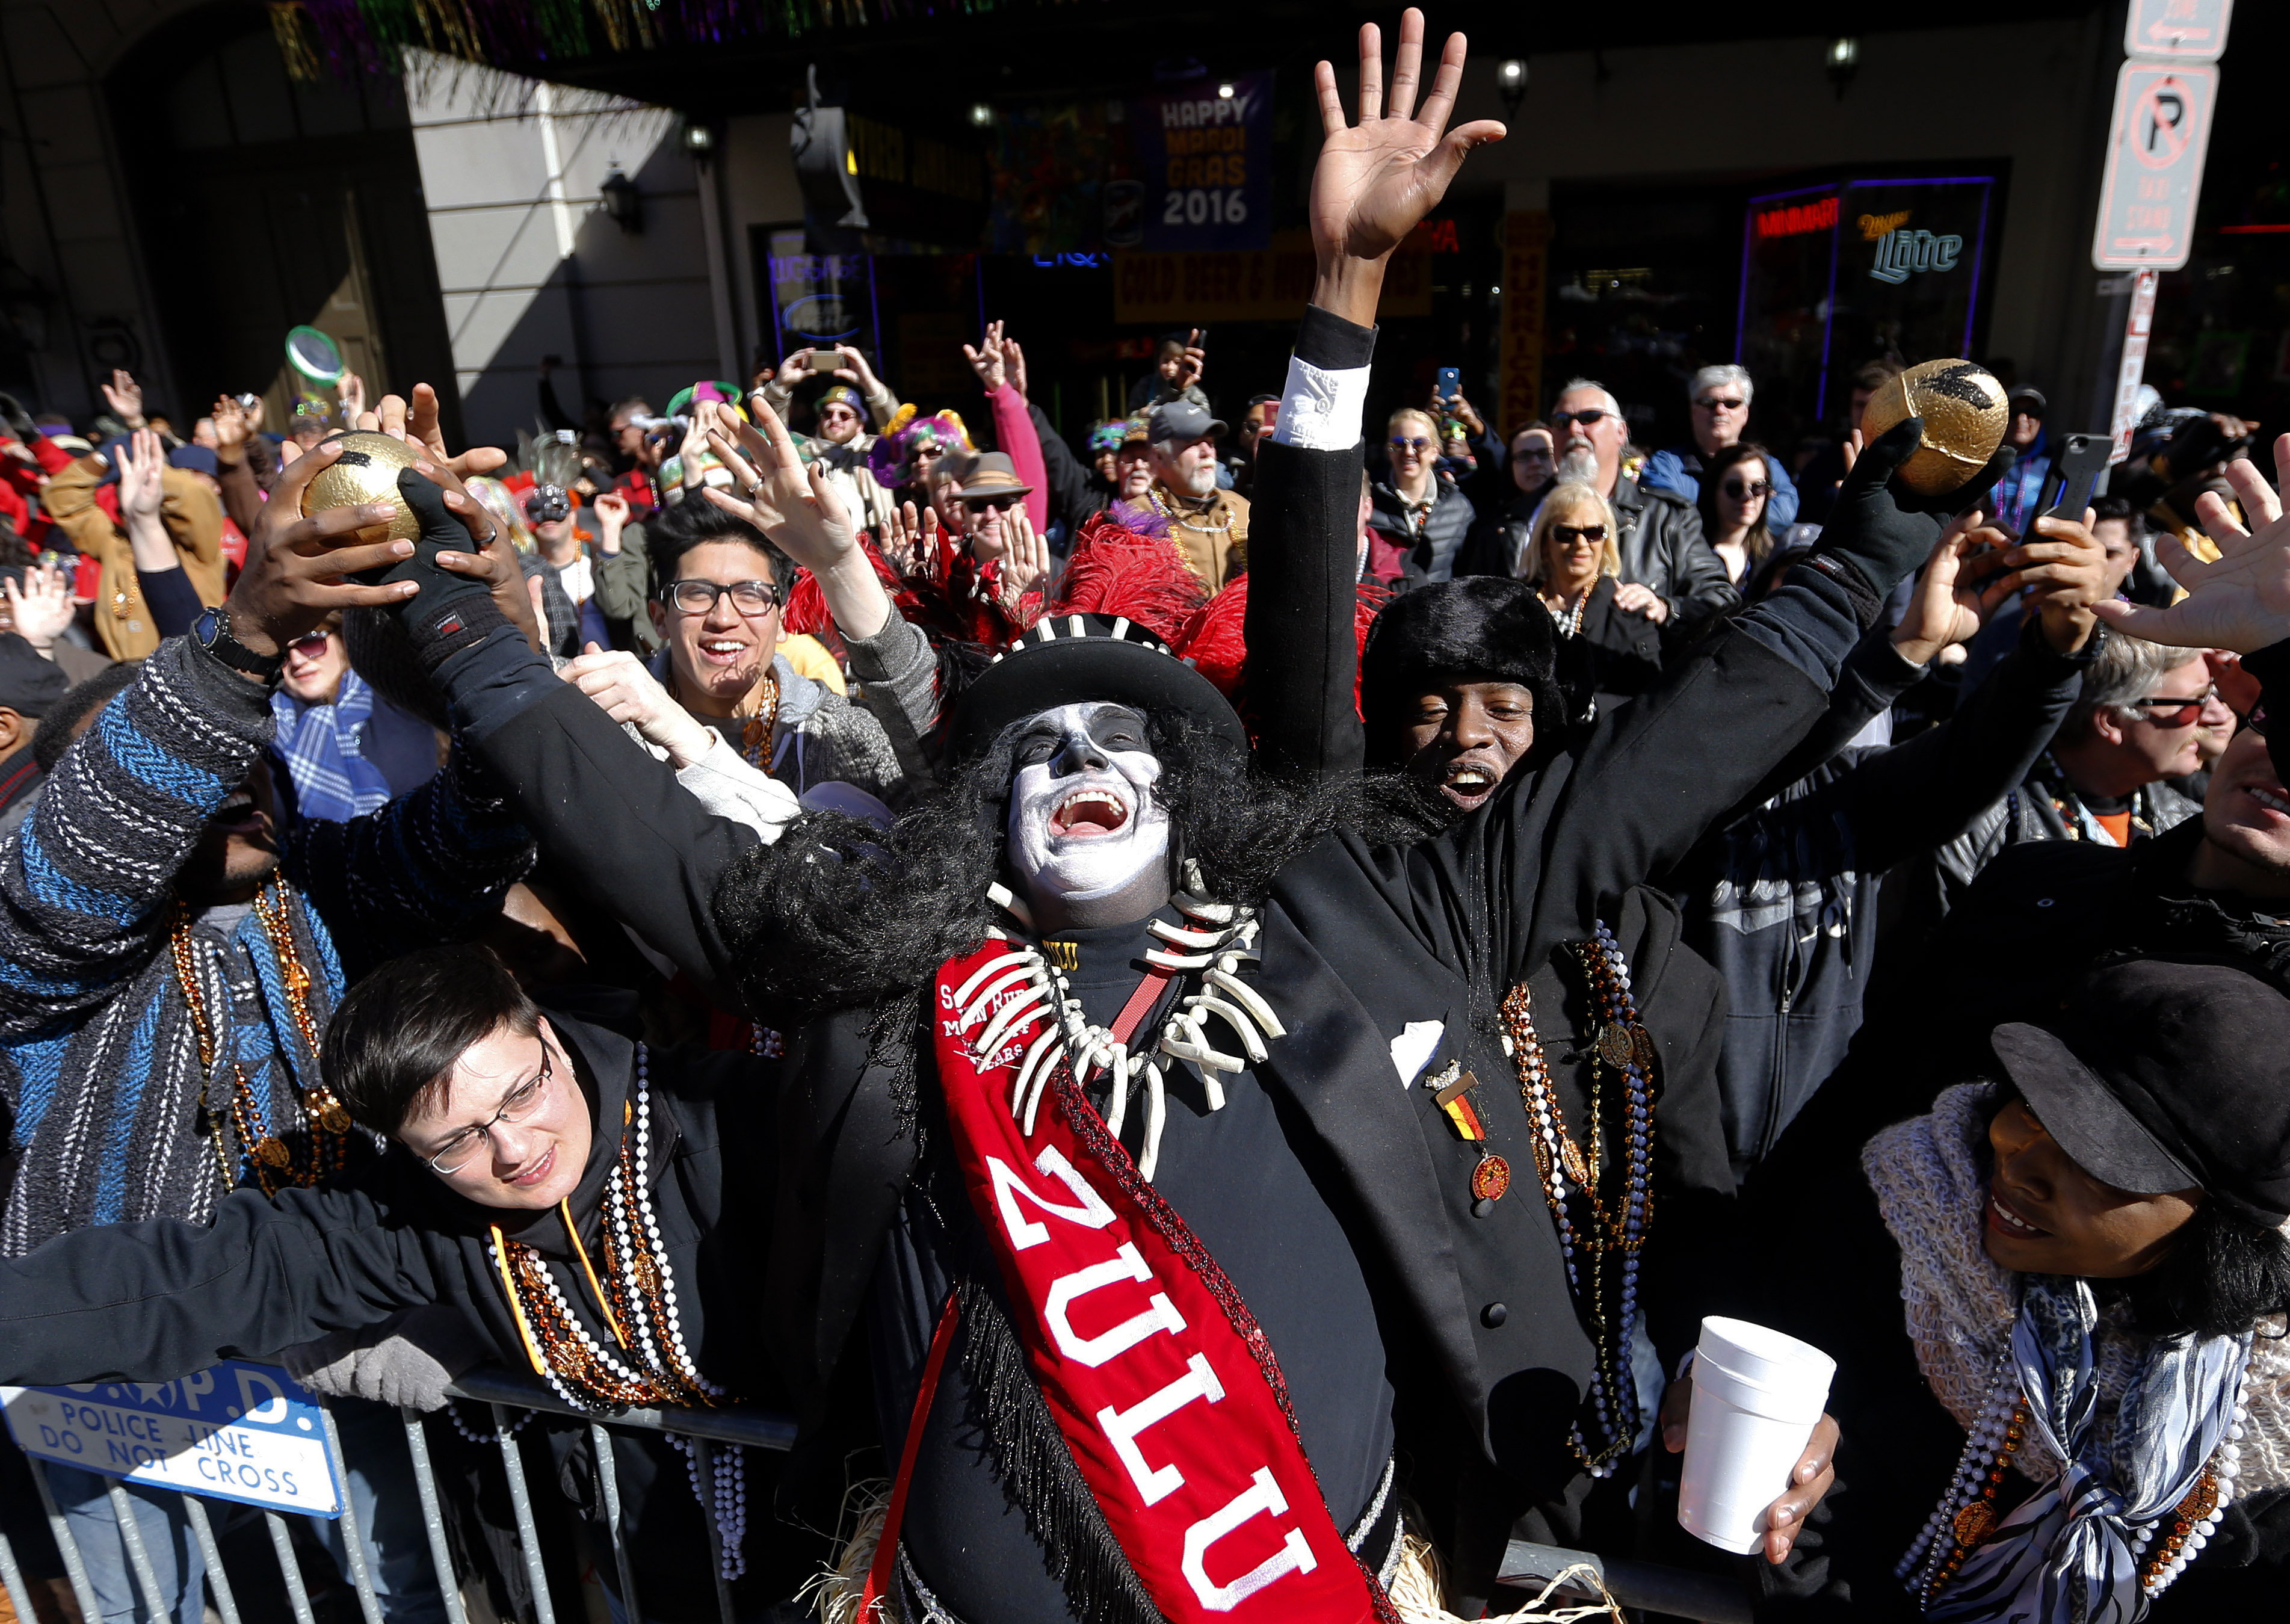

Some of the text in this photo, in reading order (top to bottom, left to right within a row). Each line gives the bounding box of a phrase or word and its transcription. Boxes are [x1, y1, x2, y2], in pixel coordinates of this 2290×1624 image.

[1161, 96, 1249, 127] HAPPY
[1165, 126, 1247, 156] MARDI
[1166, 154, 1247, 189] GRAS
[1162, 188, 1248, 226] 2016
[1122, 256, 1174, 304] COLD
[1184, 254, 1241, 302] BEER
[1868, 229, 1963, 285] Lite
[985, 1144, 1318, 1613] ZULU
[61, 1401, 255, 1459] POLICE LINE
[40, 1424, 298, 1495] DO NOT CROSS
